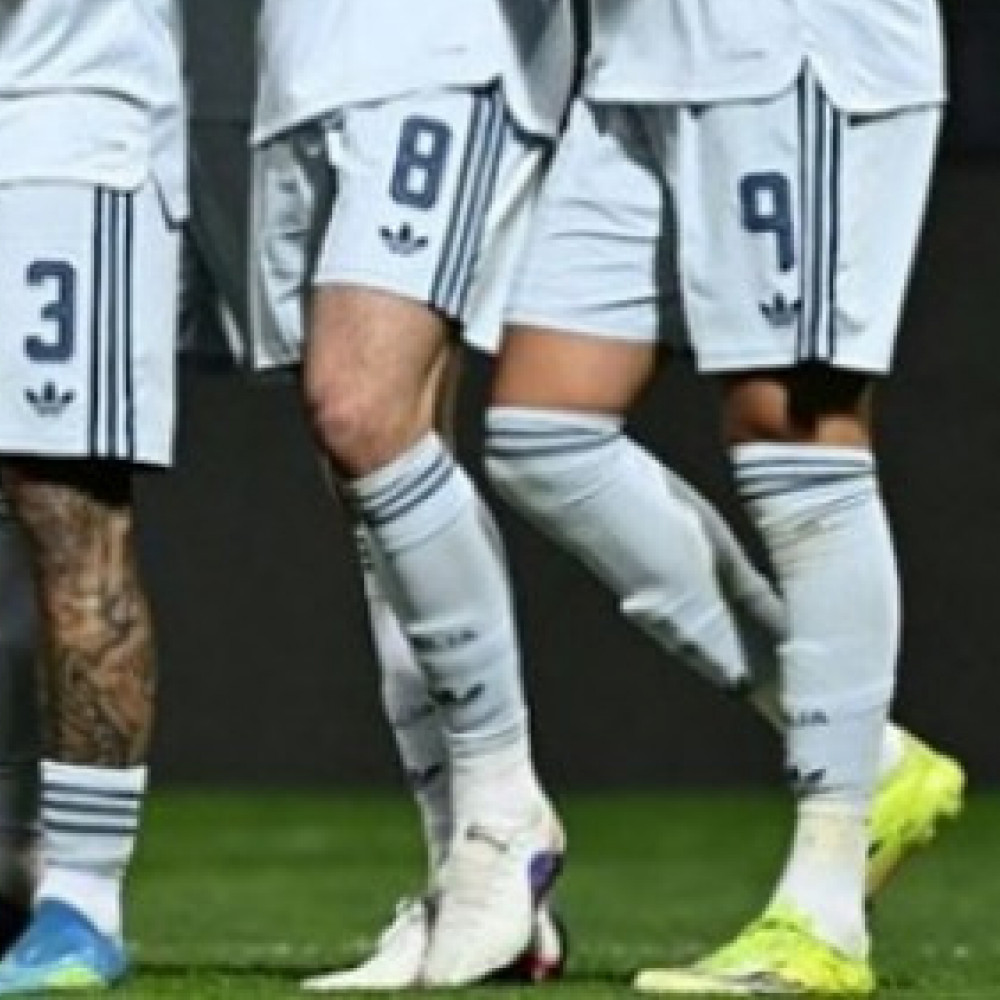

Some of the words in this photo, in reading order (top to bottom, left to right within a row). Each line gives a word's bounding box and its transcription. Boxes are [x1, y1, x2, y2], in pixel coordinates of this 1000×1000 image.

[389, 115, 453, 211] 8
[738, 171, 795, 274] 9
[24, 259, 77, 364] 3
